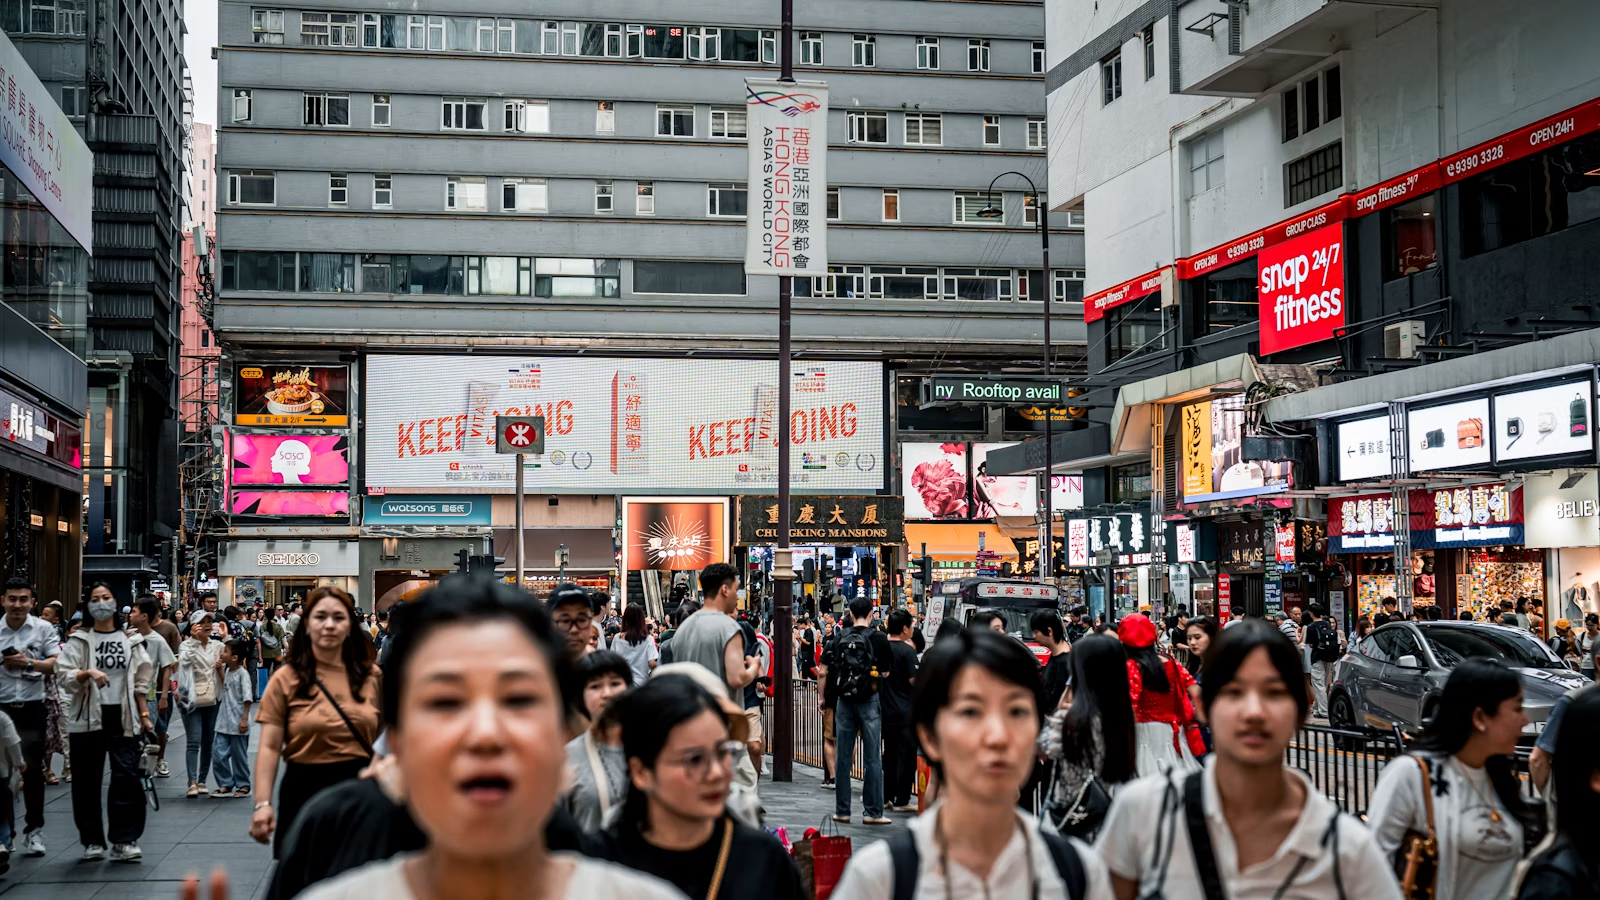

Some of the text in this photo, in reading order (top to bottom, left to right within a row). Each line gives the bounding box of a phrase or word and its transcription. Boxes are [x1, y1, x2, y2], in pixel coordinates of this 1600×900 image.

[1529, 117, 1575, 146] OPEN 24H
[27, 146, 47, 192] Shopping
[47, 170, 62, 202] Centre
[1455, 144, 1504, 175] 9390 3328
[762, 126, 773, 267] ASIA'S WORLD CITY
[774, 127, 790, 268] HONG KONG
[1356, 174, 1419, 211] snap fitness 24/7
[1285, 212, 1327, 237] GROUP CLASS
[1233, 235, 1265, 257] 9390 3328
[1194, 253, 1219, 271] OPEN 24H
[1261, 242, 1341, 294] snap 24/7
[1094, 299, 1107, 309] snap
[1106, 290, 1123, 304] fitness
[1273, 287, 1342, 332] fitness
[935, 382, 1060, 401] ny Rooftop avail
[776, 402, 858, 446] OING
[388, 504, 436, 513] watsons
[755, 528, 888, 538] CHUGKING MANSIONS
[258, 553, 320, 566] SEIKO
